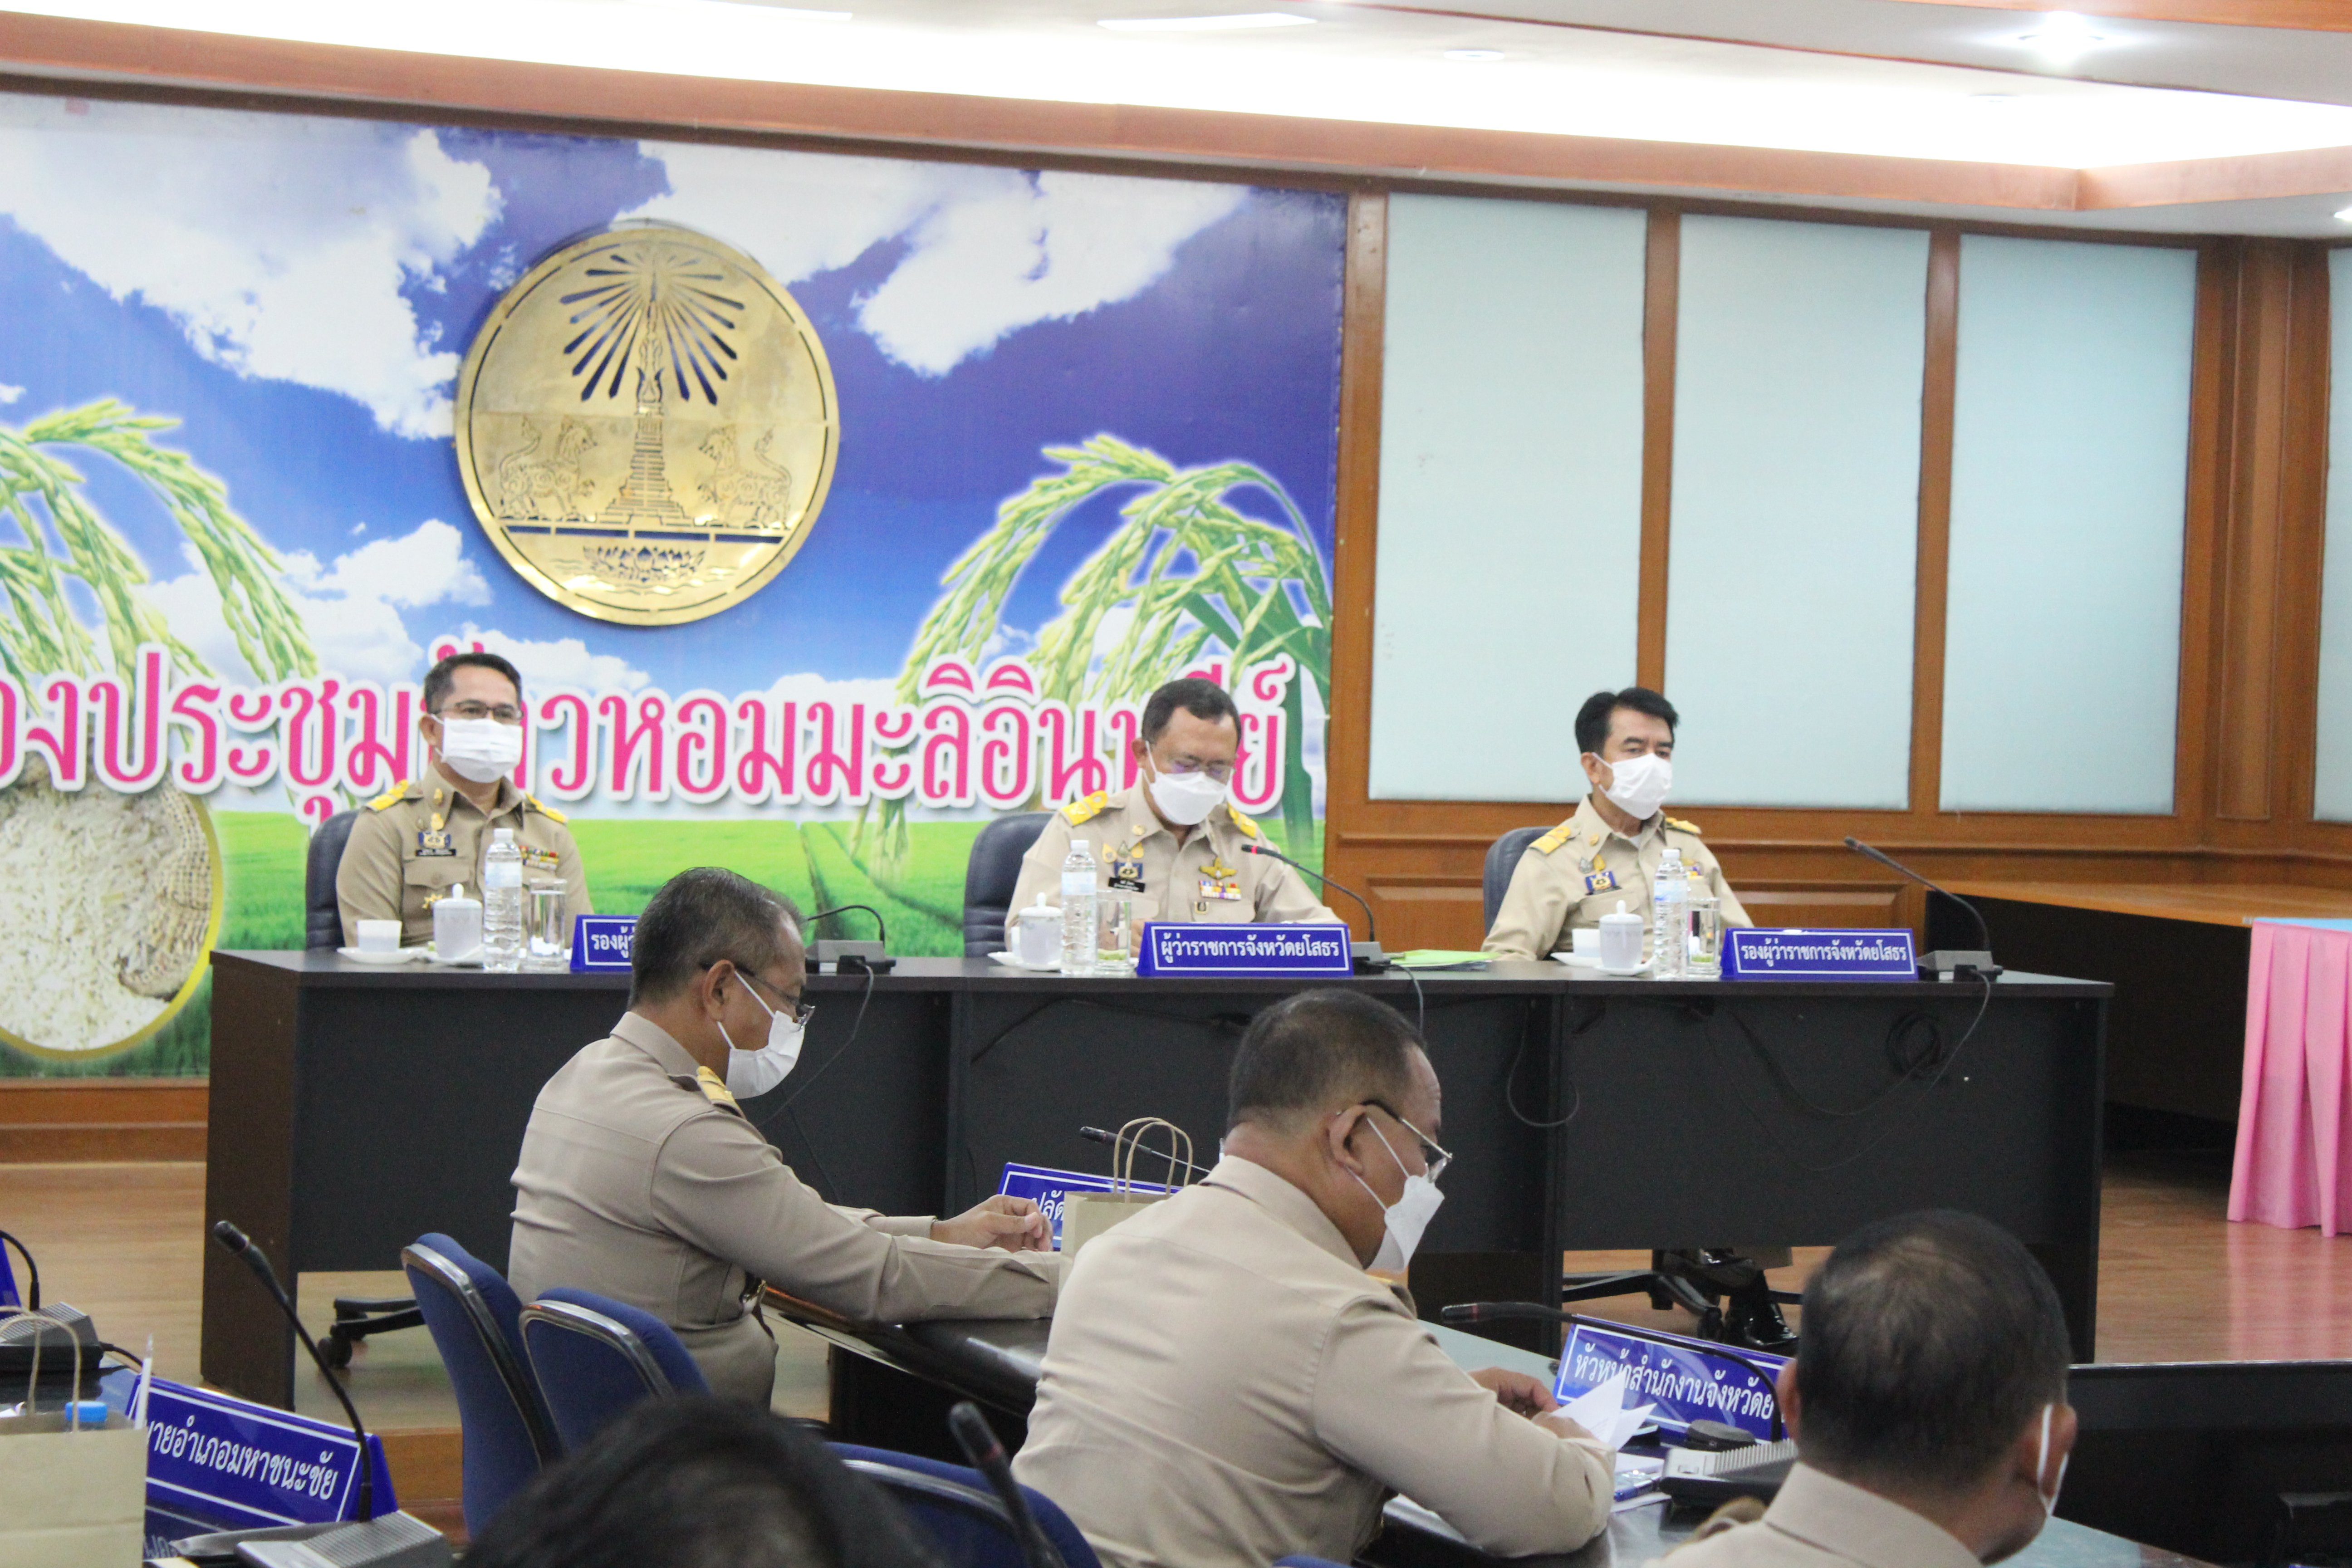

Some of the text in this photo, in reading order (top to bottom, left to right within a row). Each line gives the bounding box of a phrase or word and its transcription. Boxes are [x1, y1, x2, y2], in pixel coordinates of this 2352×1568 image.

[0, 641, 1287, 823] งประชุมวหอมมะลิอินย์
[1161, 932, 1339, 963] ผู้ว่าราชการจังหวัดยโสธร
[1741, 938, 1906, 967] รองผู้ว่าราชการจังหวัดยโสธร
